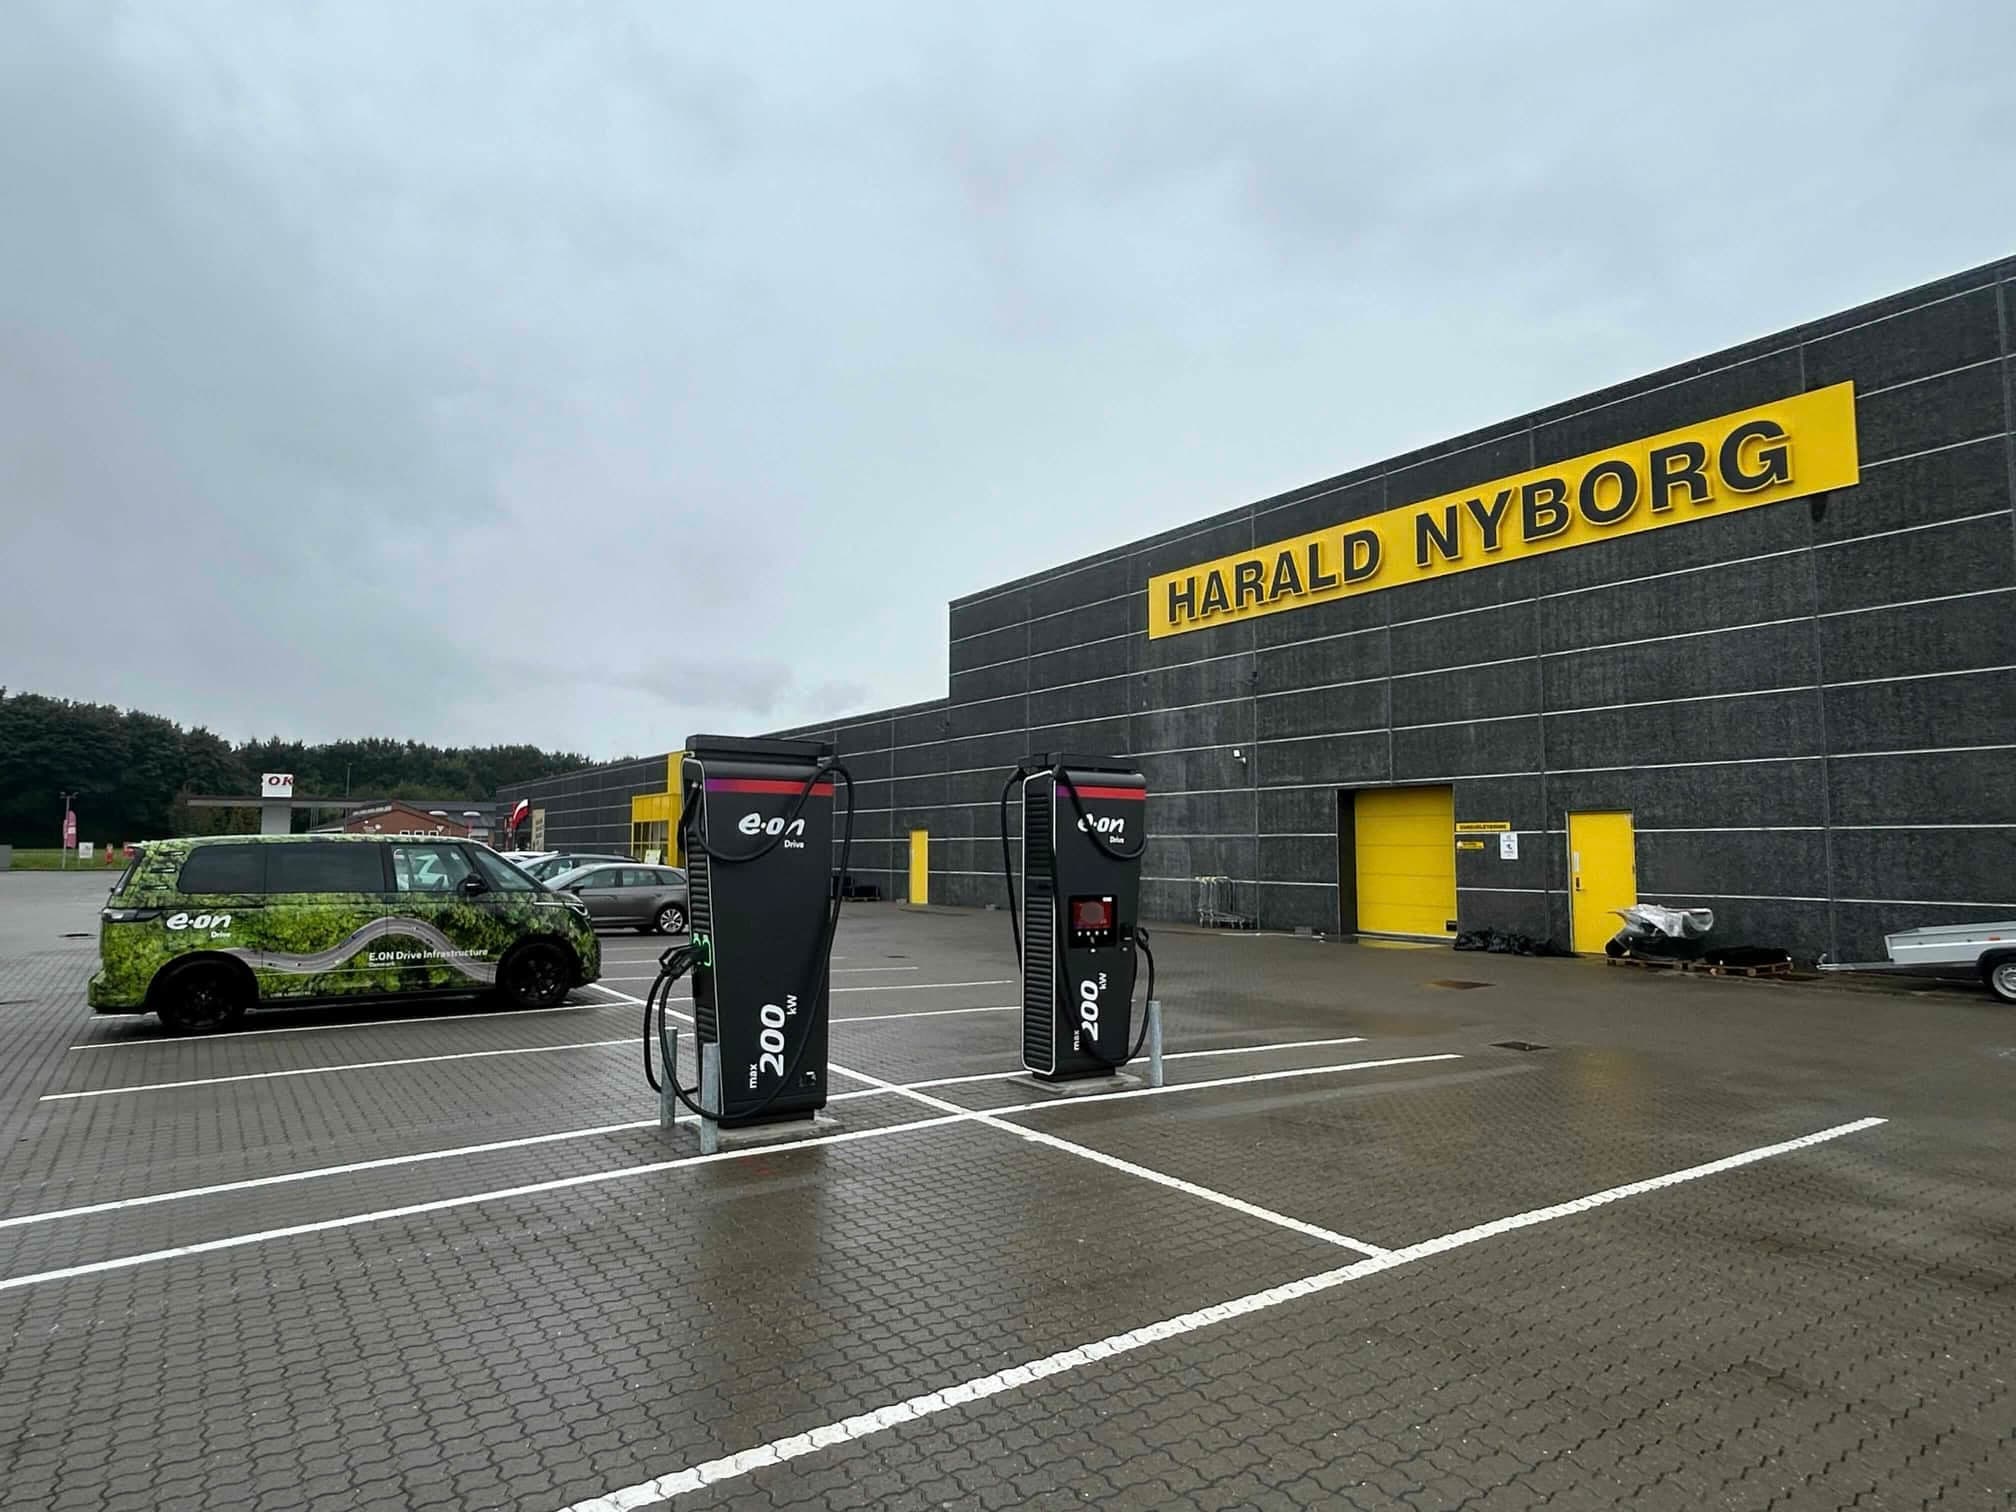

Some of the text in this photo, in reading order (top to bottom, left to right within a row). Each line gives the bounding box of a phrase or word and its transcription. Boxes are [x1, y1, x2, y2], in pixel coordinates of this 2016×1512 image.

[1168, 419, 1793, 625] HARALD NYBORG
[268, 775, 295, 786] OK
[784, 840, 805, 849] Drive
[368, 948, 489, 962] E.ON Drive Infrastructure
[1080, 980, 1099, 1041] 200
[1099, 972, 1107, 990] kW
[749, 994, 798, 1089] max 200 kW
